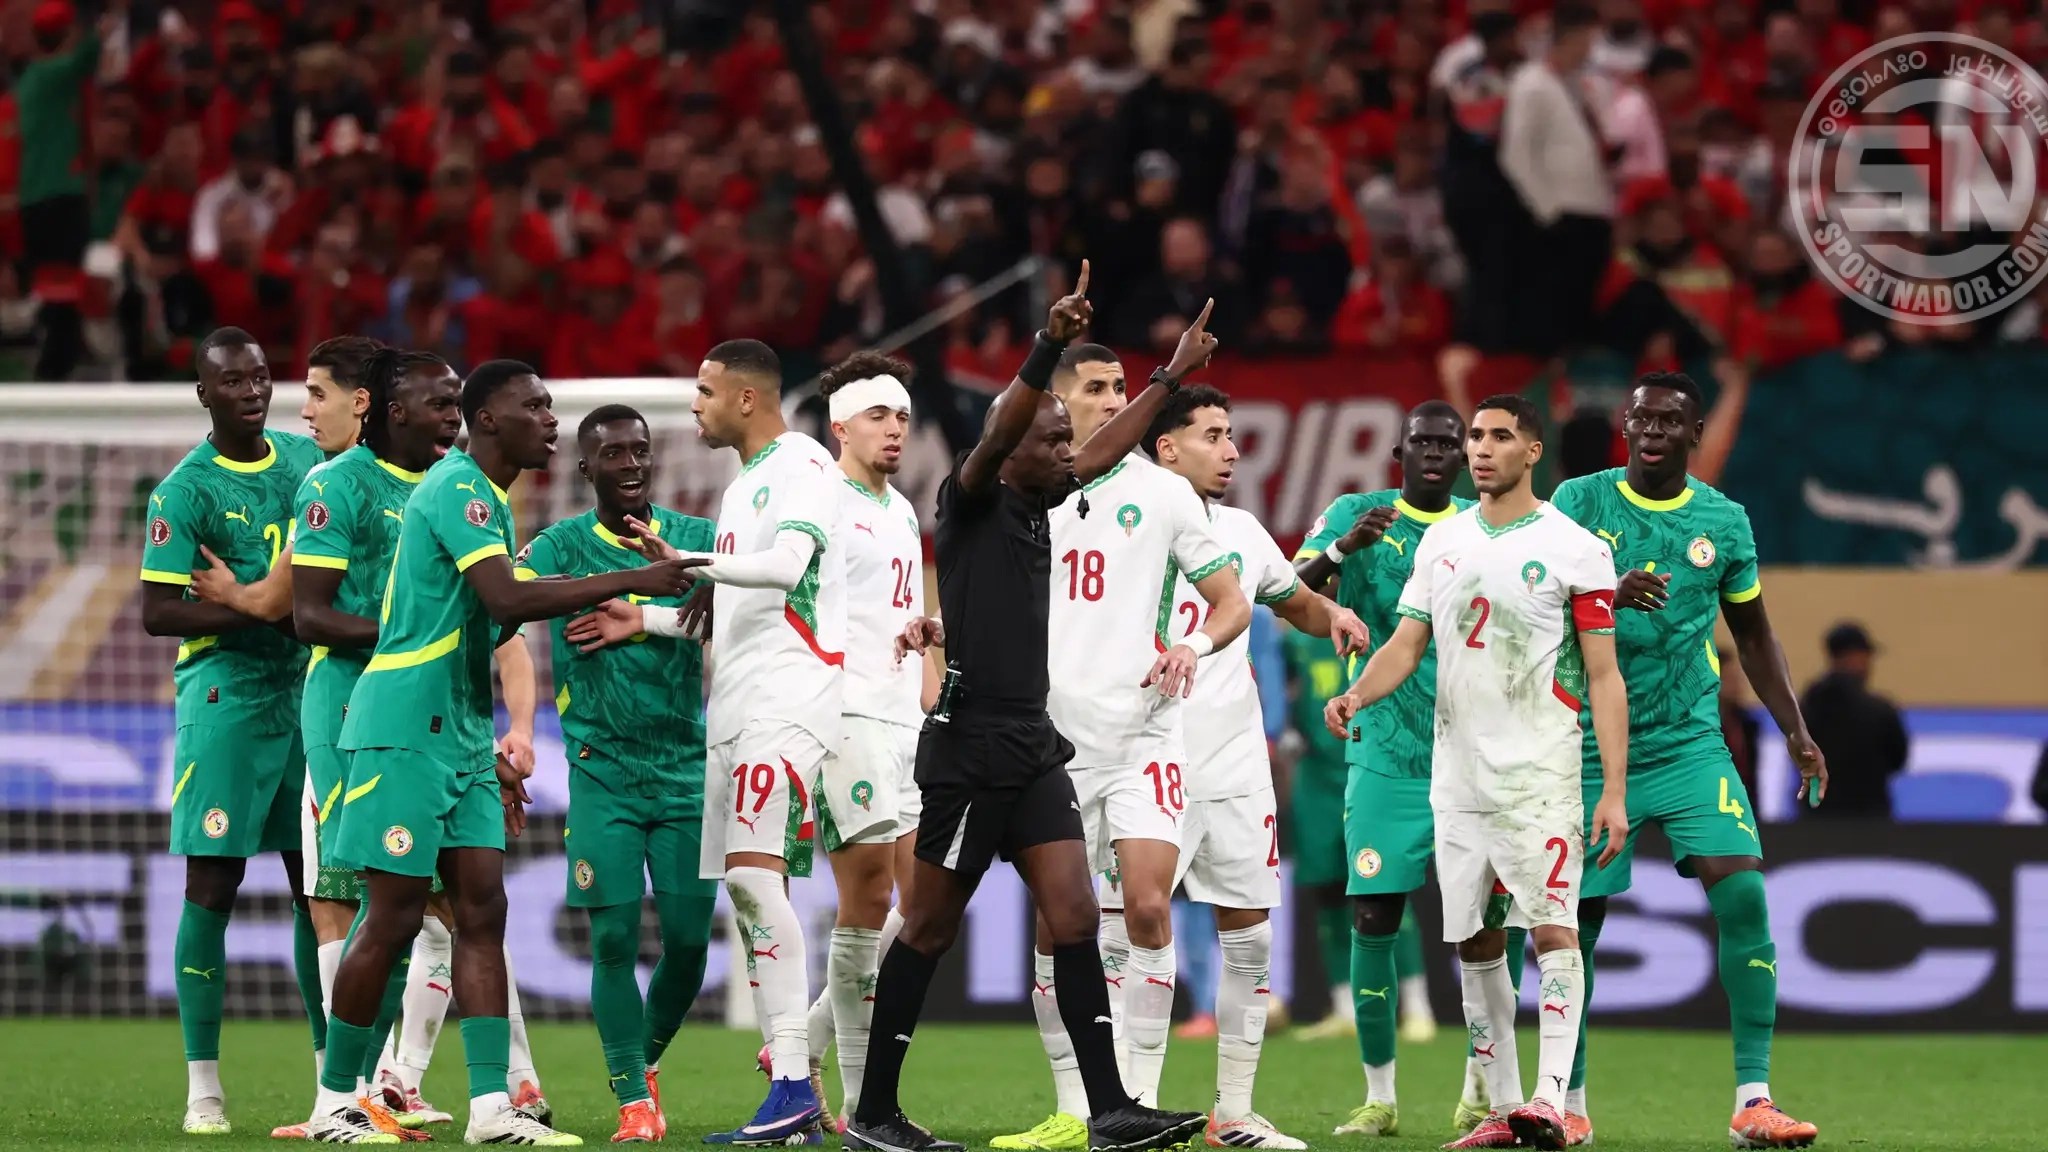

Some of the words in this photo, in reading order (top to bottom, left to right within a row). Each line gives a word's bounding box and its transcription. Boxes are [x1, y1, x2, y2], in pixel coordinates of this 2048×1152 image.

[892, 557, 913, 609] 24
[1062, 549, 1105, 601] 18
[1466, 596, 1491, 650] 2
[732, 762, 776, 814] 19
[1143, 761, 1184, 810] 18
[1718, 776, 1745, 819] 4
[1544, 836, 1570, 890] 2
